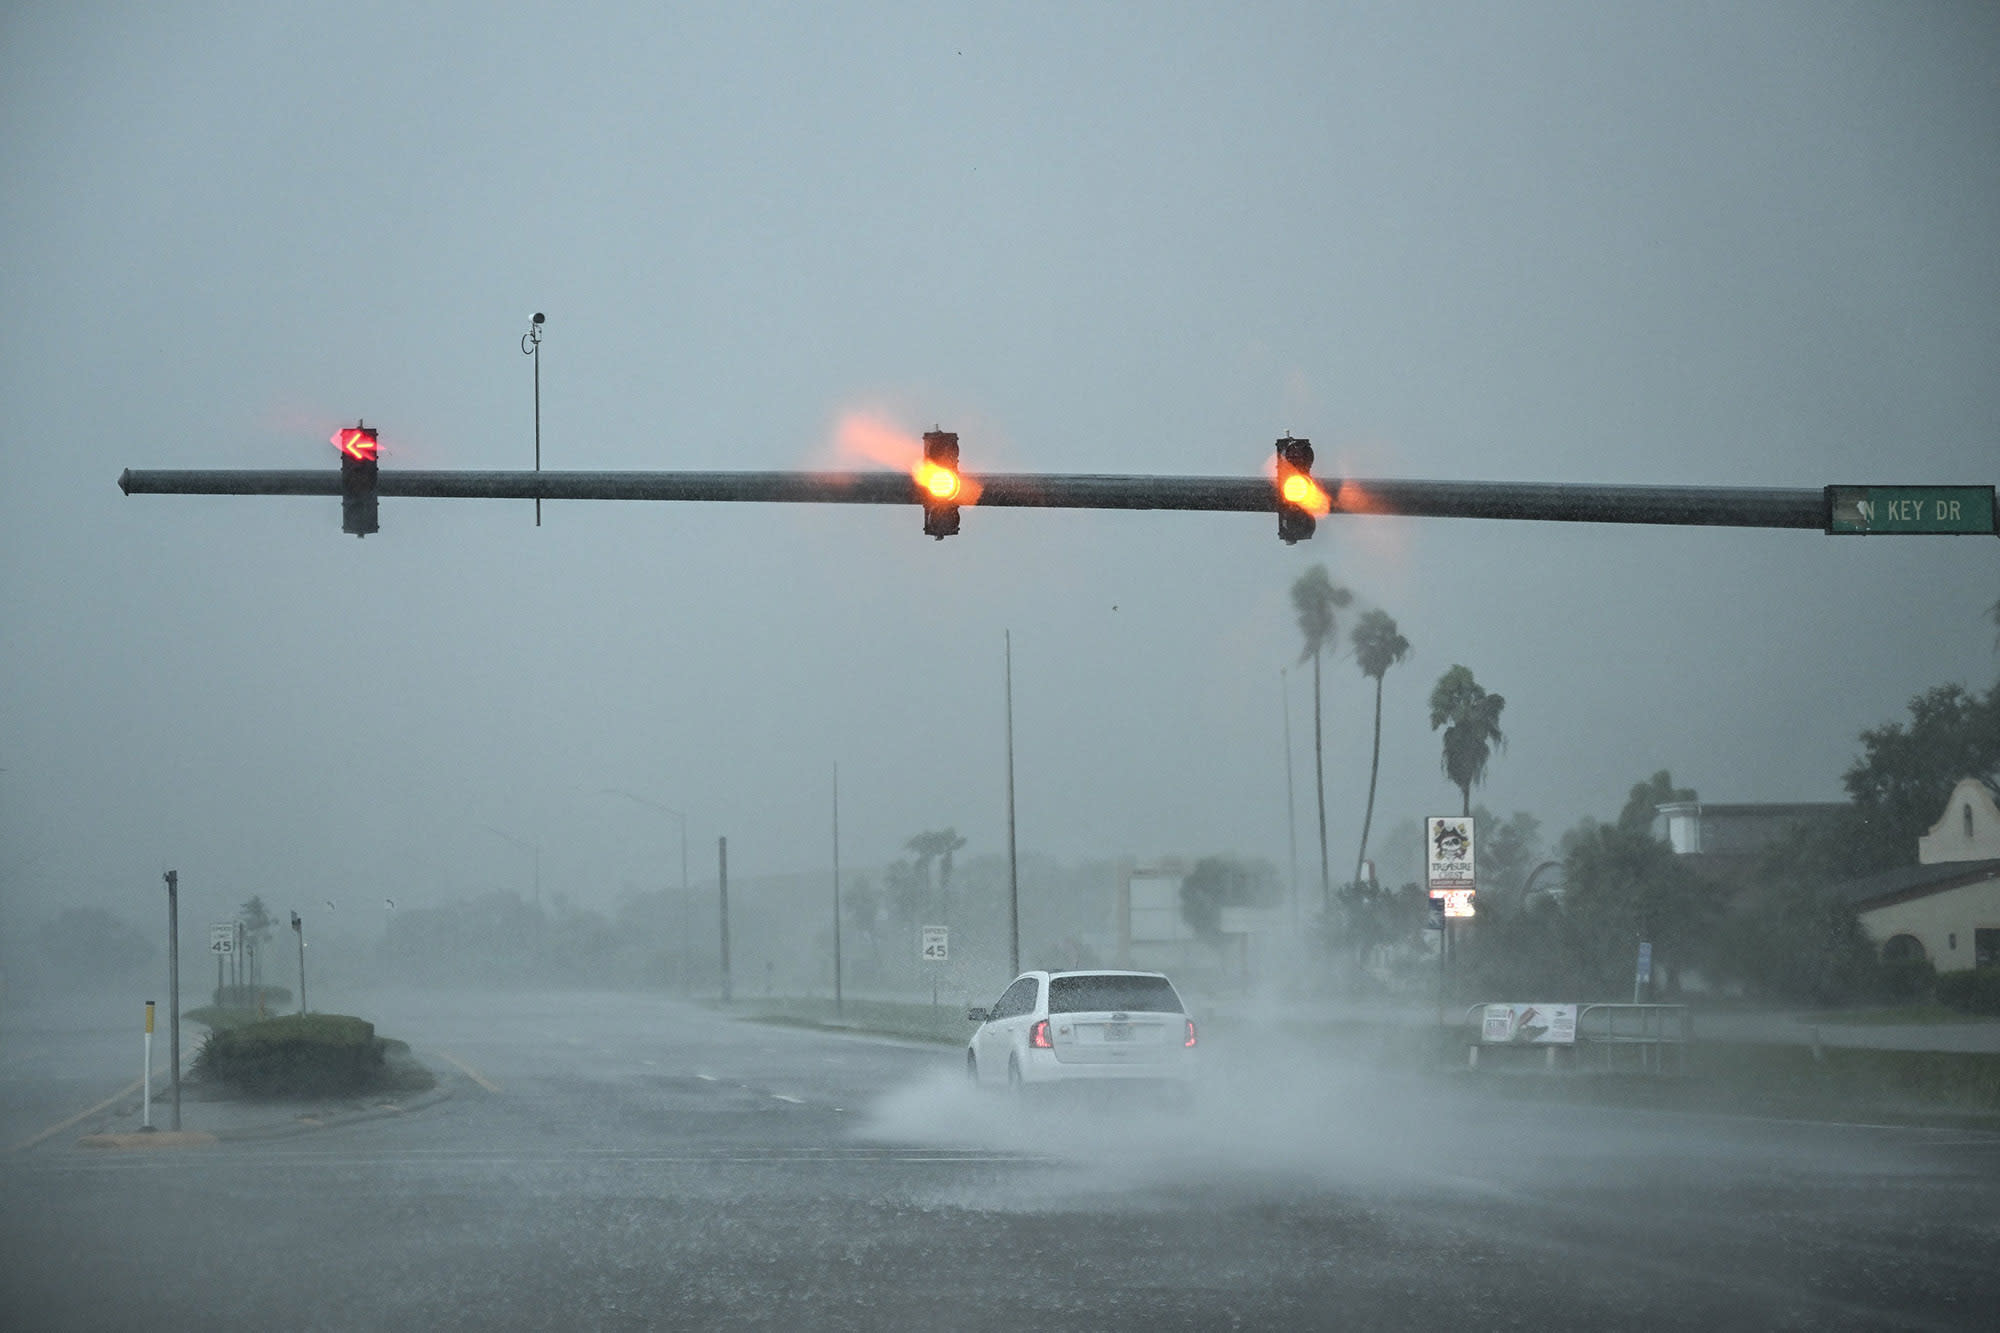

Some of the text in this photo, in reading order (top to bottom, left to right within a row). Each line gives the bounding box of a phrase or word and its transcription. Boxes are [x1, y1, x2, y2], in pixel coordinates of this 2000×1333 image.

[1888, 500, 1924, 521] KEY
[1936, 500, 1961, 521] DR
[1432, 862, 1472, 871] TREASURE
[212, 941, 232, 952] 45
[925, 945, 946, 957] 45
